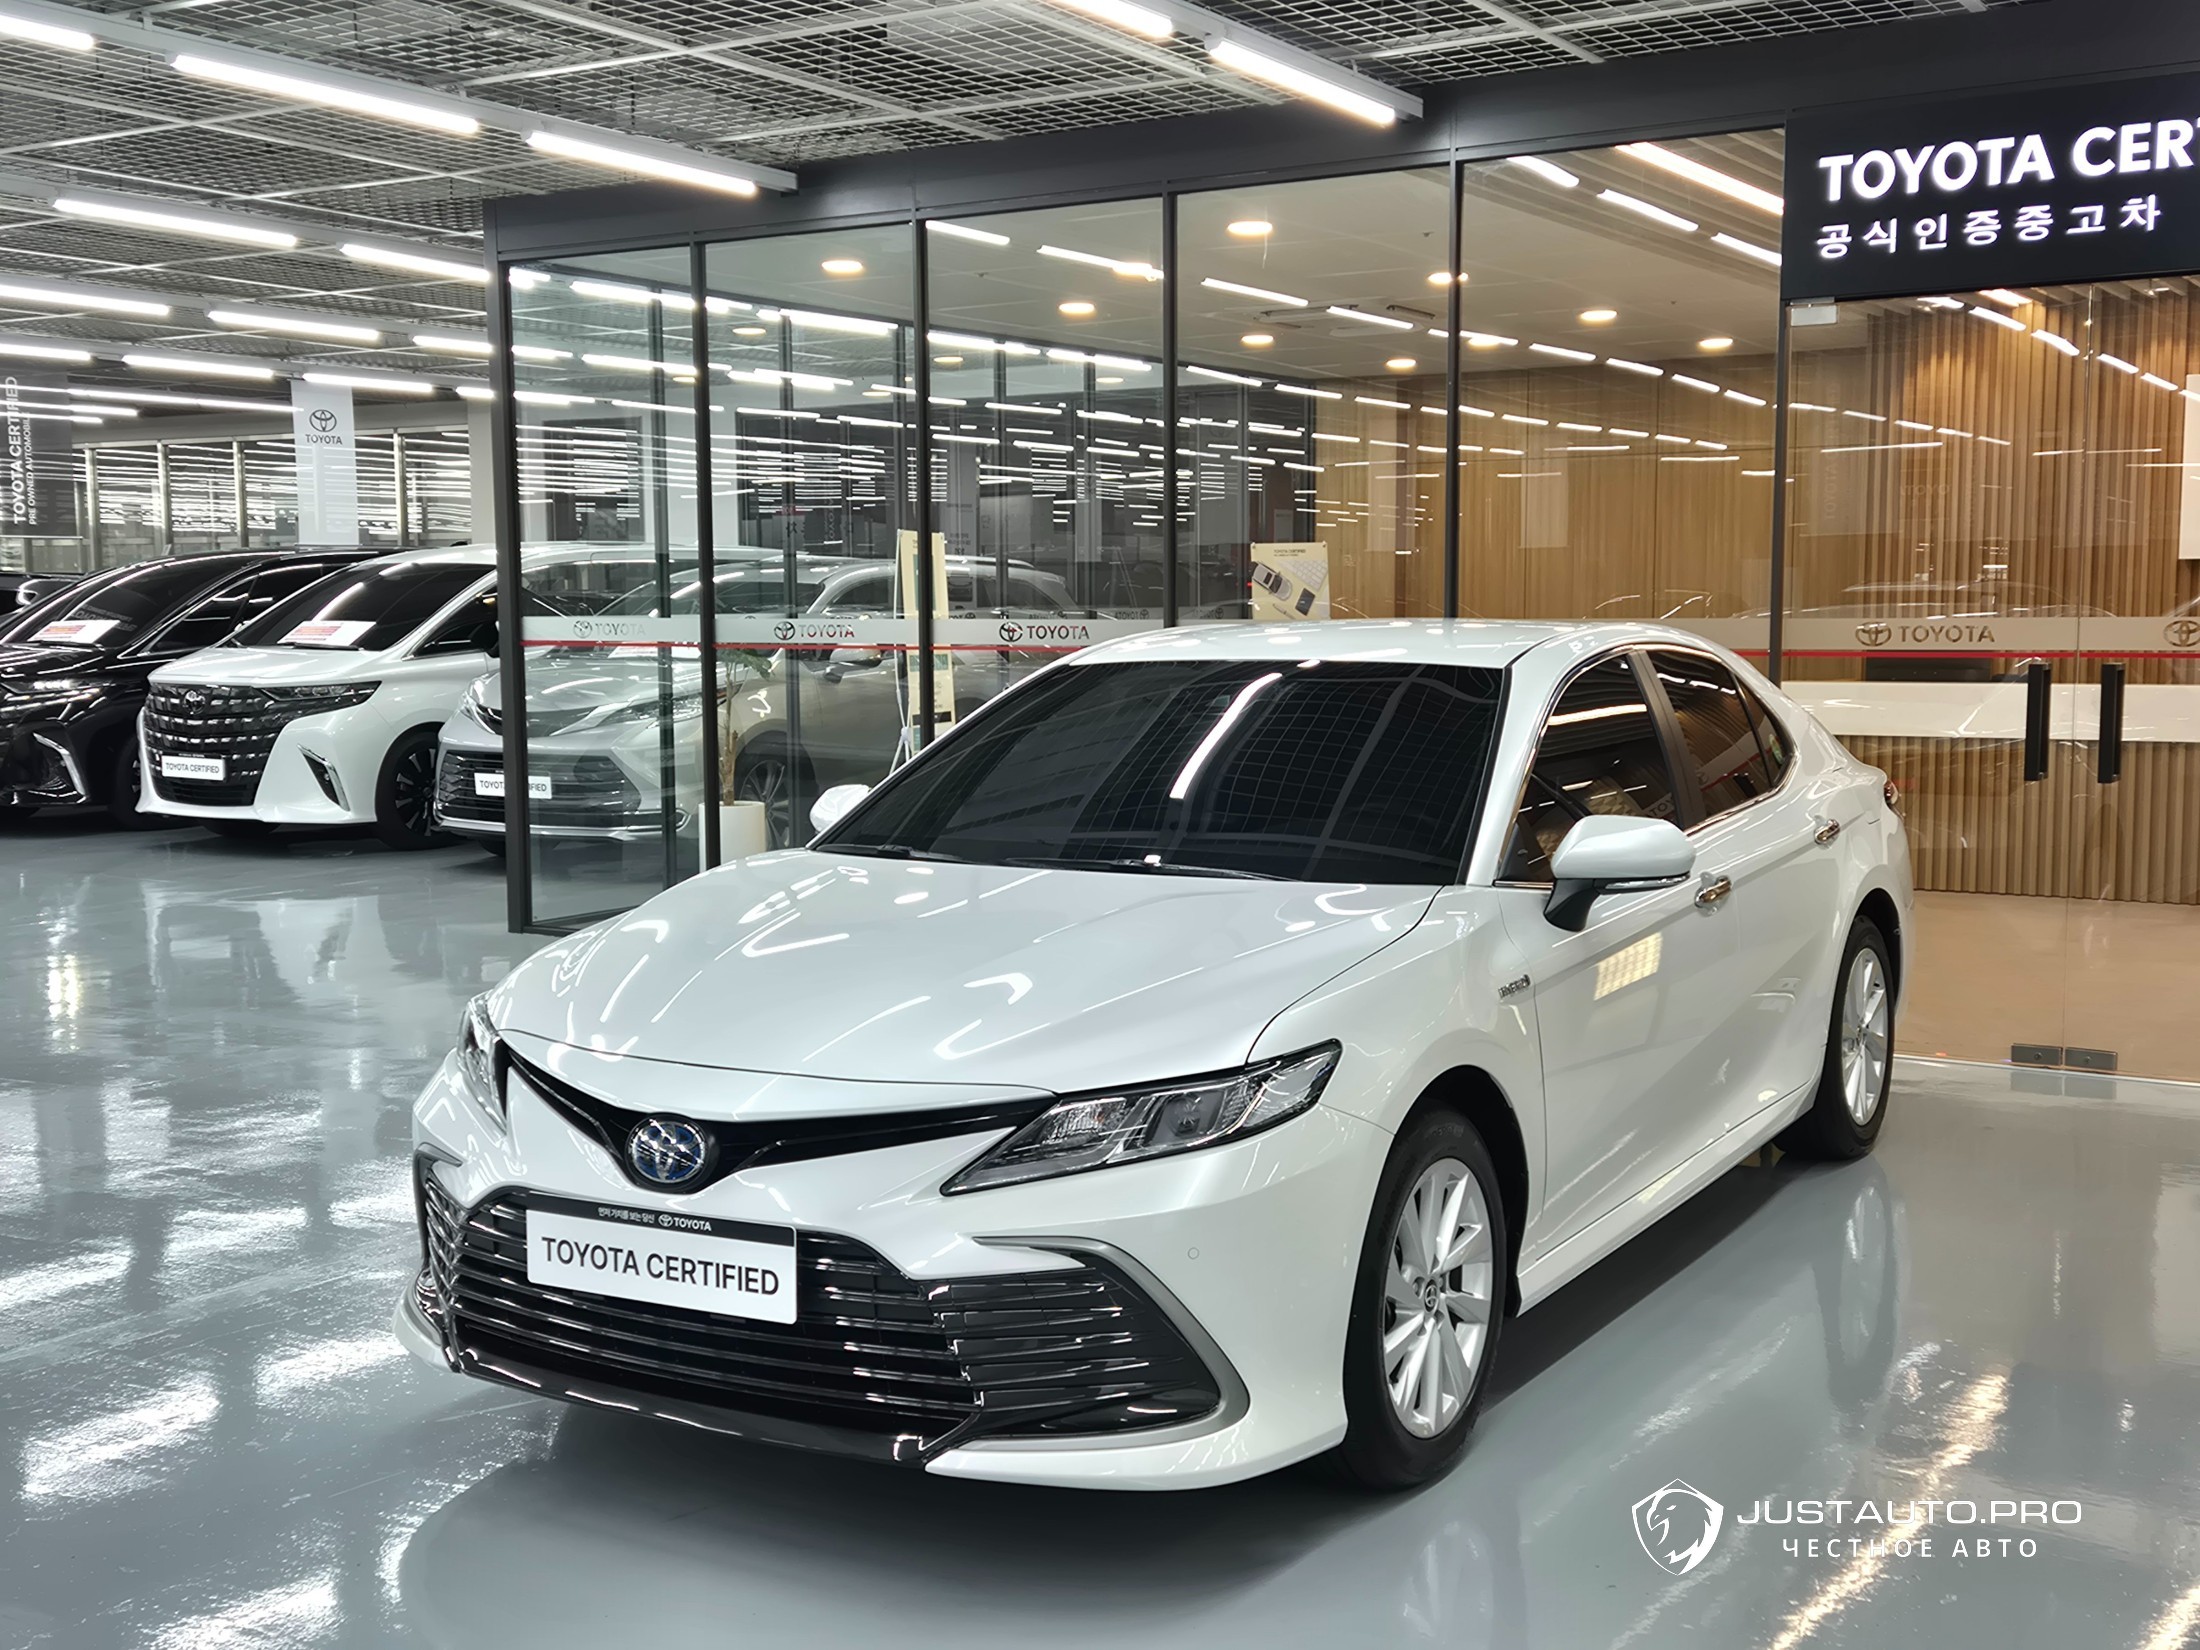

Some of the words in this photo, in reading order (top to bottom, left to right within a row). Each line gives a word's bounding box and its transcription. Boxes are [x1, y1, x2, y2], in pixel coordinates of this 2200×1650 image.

[1818, 133, 2055, 202] TOYOTA
[2072, 117, 2200, 178] CER
[1815, 193, 2162, 259] 공식인증중고차
[22, 411, 34, 471] AUTOMOBIL
[305, 434, 343, 445] TOYOTA
[10, 461, 27, 525] TOYOTA
[26, 471, 36, 507] OWNED
[28, 508, 38, 525] PRE
[594, 623, 646, 637] TOYOTA
[798, 624, 855, 638] TOYOTA
[1026, 625, 1090, 640] TOYOTA
[1898, 625, 1995, 643] TOYOTA
[165, 762, 189, 772] TOYOTA
[189, 764, 220, 774] CERTIFIED
[479, 780, 505, 789] TOYOT
[673, 1217, 712, 1231] TOYOTA
[541, 1236, 640, 1276] TOYOTA
[646, 1253, 780, 1296] CERTIFIED
